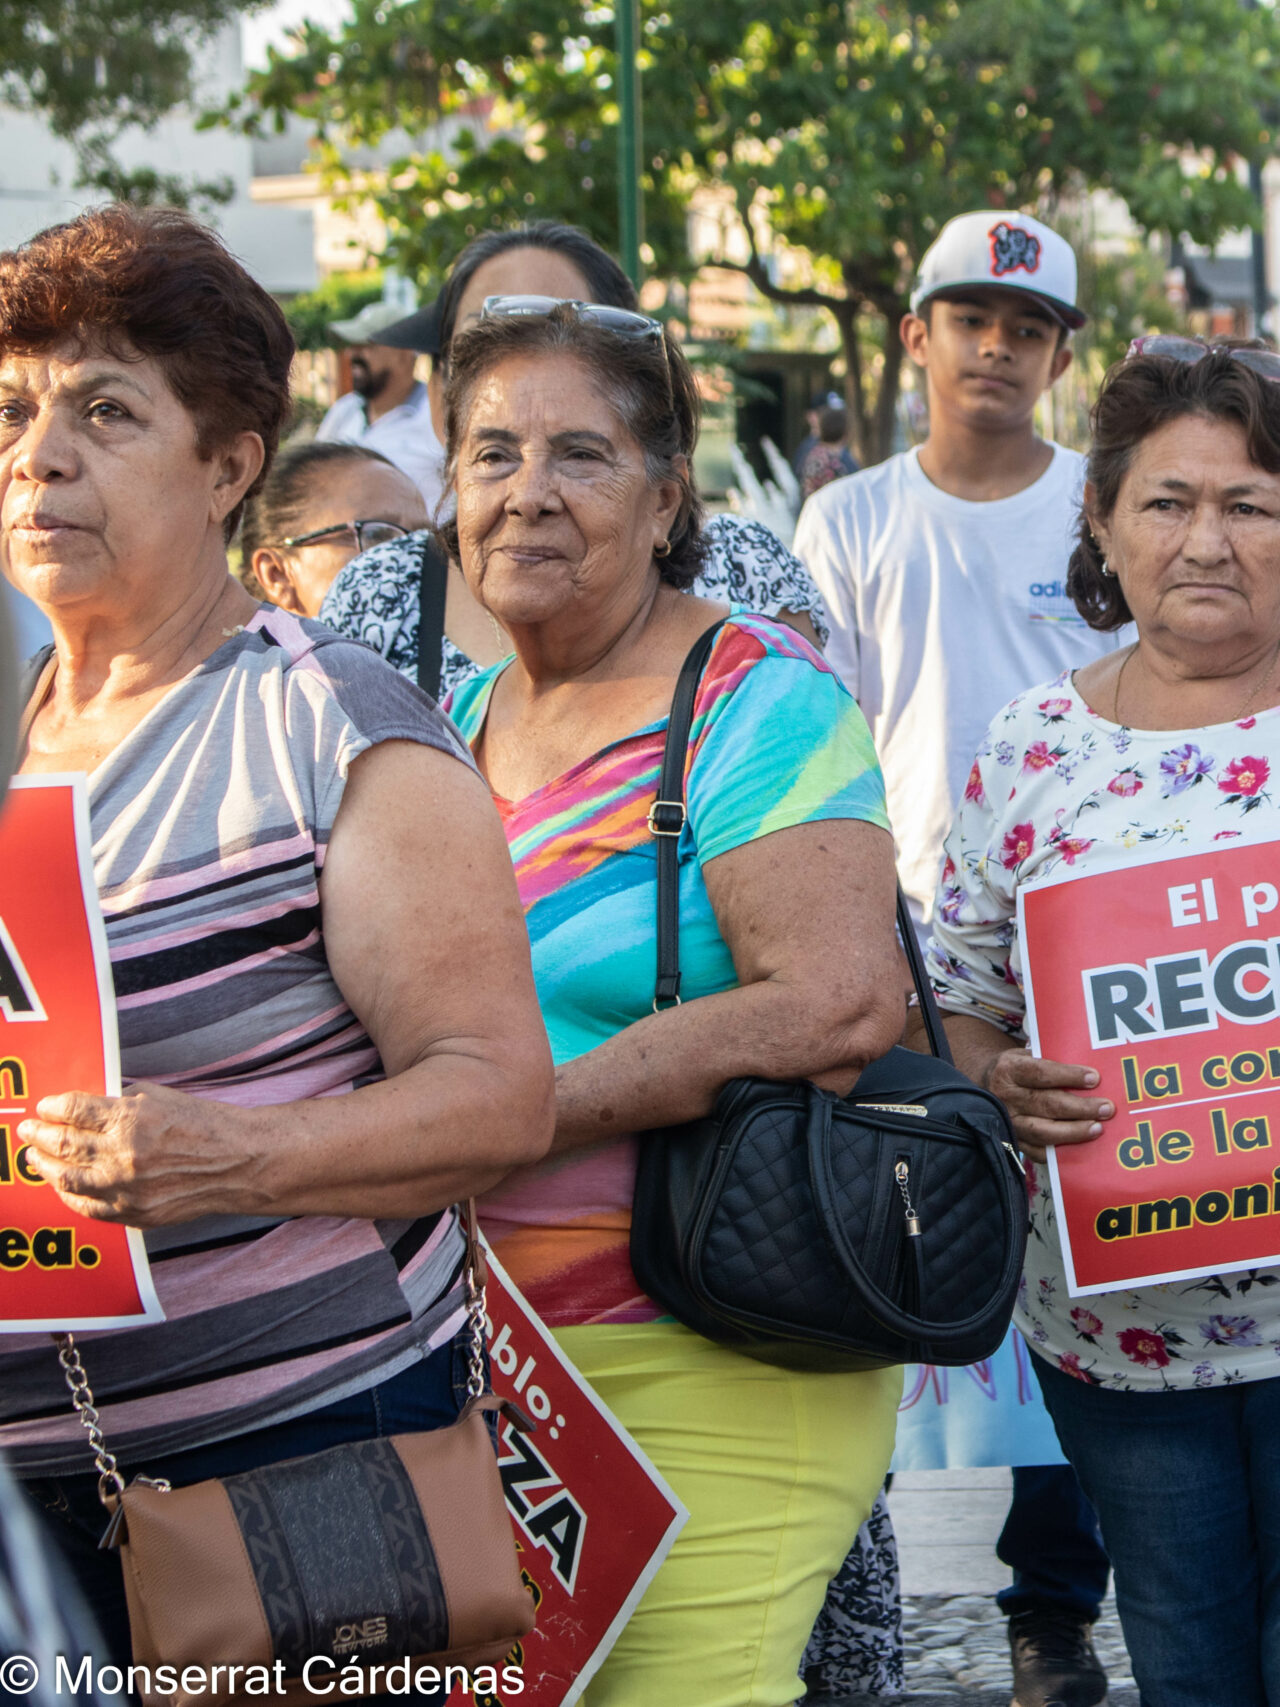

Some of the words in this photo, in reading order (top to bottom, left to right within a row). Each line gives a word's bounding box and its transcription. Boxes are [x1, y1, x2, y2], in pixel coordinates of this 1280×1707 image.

[1167, 877, 1219, 928] El
[1121, 1055, 1182, 1104] la
[1116, 1120, 1195, 1172] de
[1209, 1104, 1271, 1157] la
[0, 1226, 101, 1271] ea.
[332, 1617, 389, 1645] JONES
[359, 1632, 389, 1649] YORK
